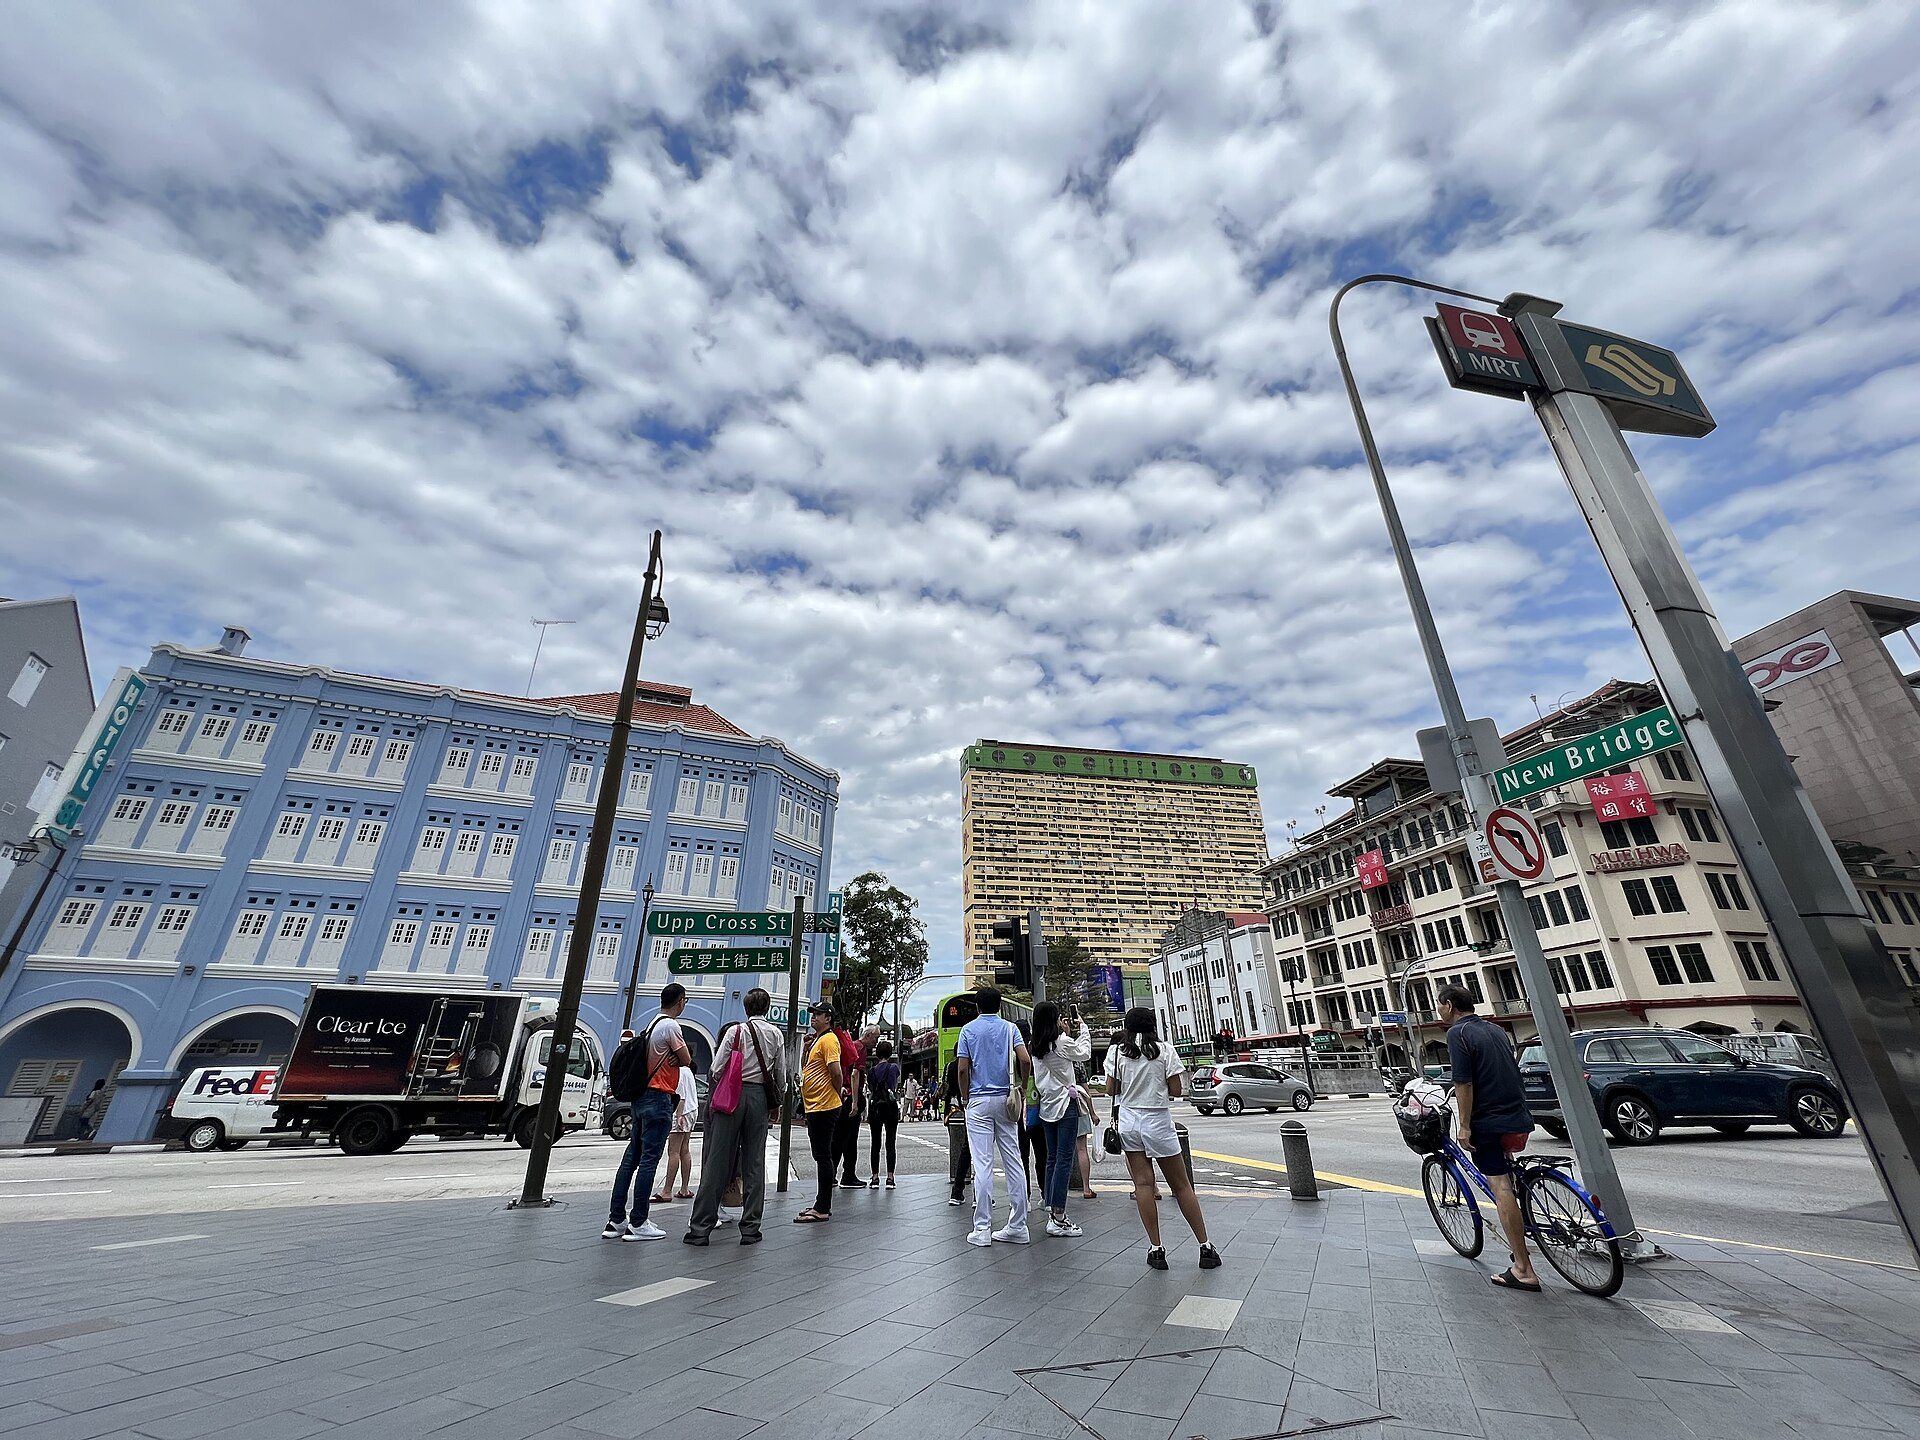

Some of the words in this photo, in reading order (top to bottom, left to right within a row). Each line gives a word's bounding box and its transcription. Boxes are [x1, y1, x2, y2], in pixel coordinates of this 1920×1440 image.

[1468, 352, 1522, 379] MRT
[80, 684, 139, 792] HOTEL
[1501, 761, 1555, 792] New
[1564, 718, 1674, 770] Bridge
[55, 800, 84, 829] 81
[1589, 849, 1635, 866] YUE
[1634, 843, 1690, 861] HWA
[656, 913, 695, 932] Upp
[705, 913, 758, 931] Cross
[767, 915, 787, 930] St
[678, 952, 785, 969] 克罗士街上段
[316, 1015, 374, 1034] Clear
[376, 1018, 406, 1035] Ice
[193, 1070, 277, 1097] FedE
[246, 1097, 265, 1108] Exp
